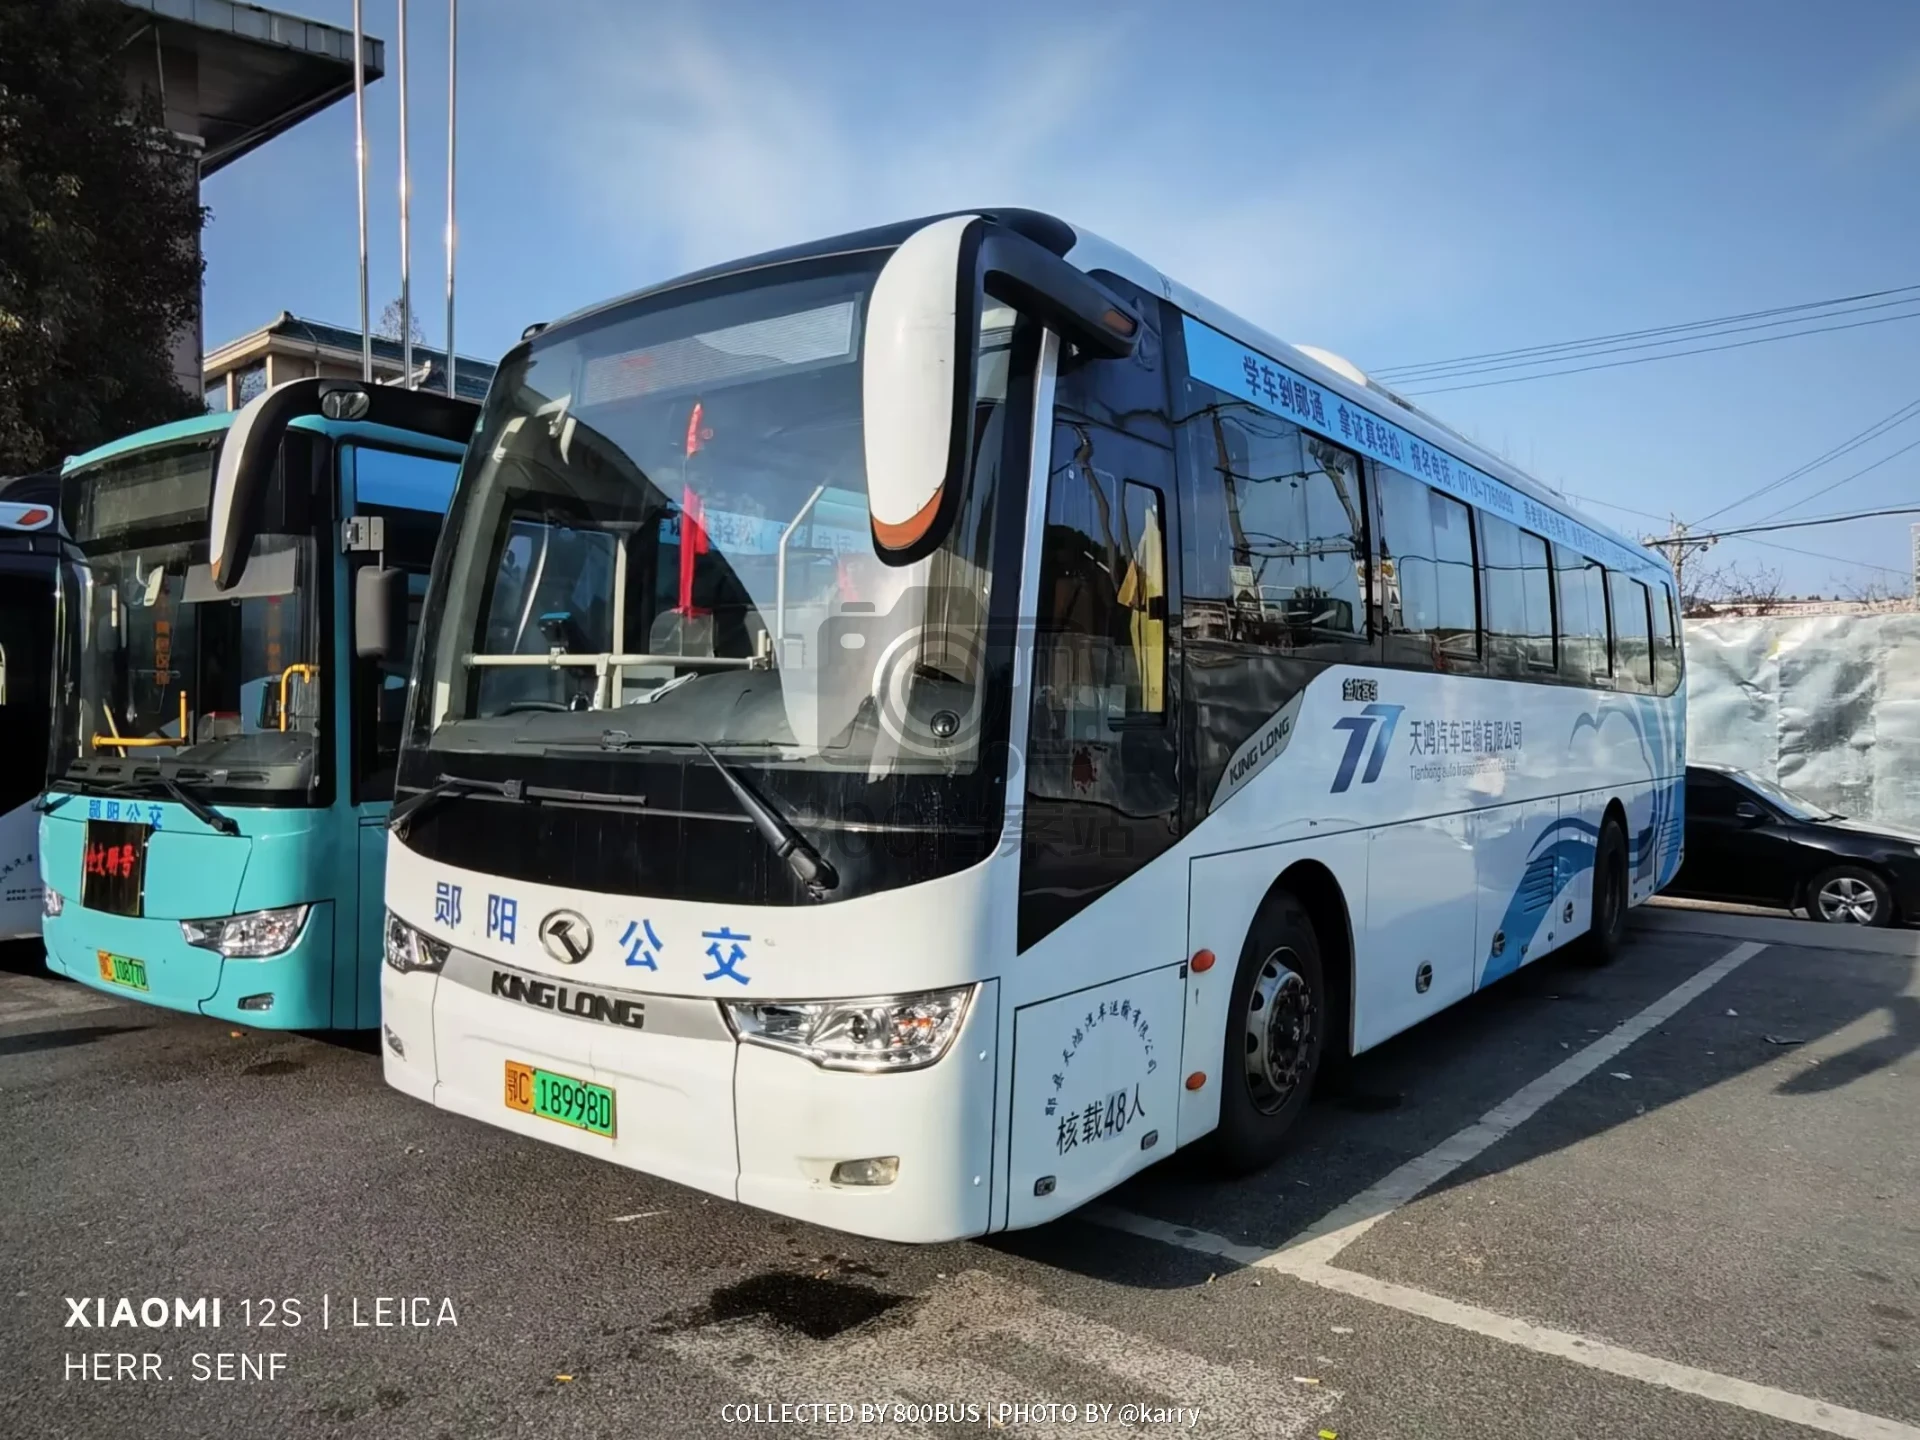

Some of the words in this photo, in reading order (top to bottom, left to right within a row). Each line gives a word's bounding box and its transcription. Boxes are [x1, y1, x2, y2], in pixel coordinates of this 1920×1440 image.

[1342, 677, 1378, 702] 金龙客车
[1229, 746, 1258, 785] KING
[1260, 716, 1290, 757] LONG
[1409, 720, 1523, 755] 天鸿汽车运输有限公司
[491, 970, 556, 1010] KING
[558, 987, 645, 1030] LONG
[1056, 1083, 1145, 1156] 核载48人
